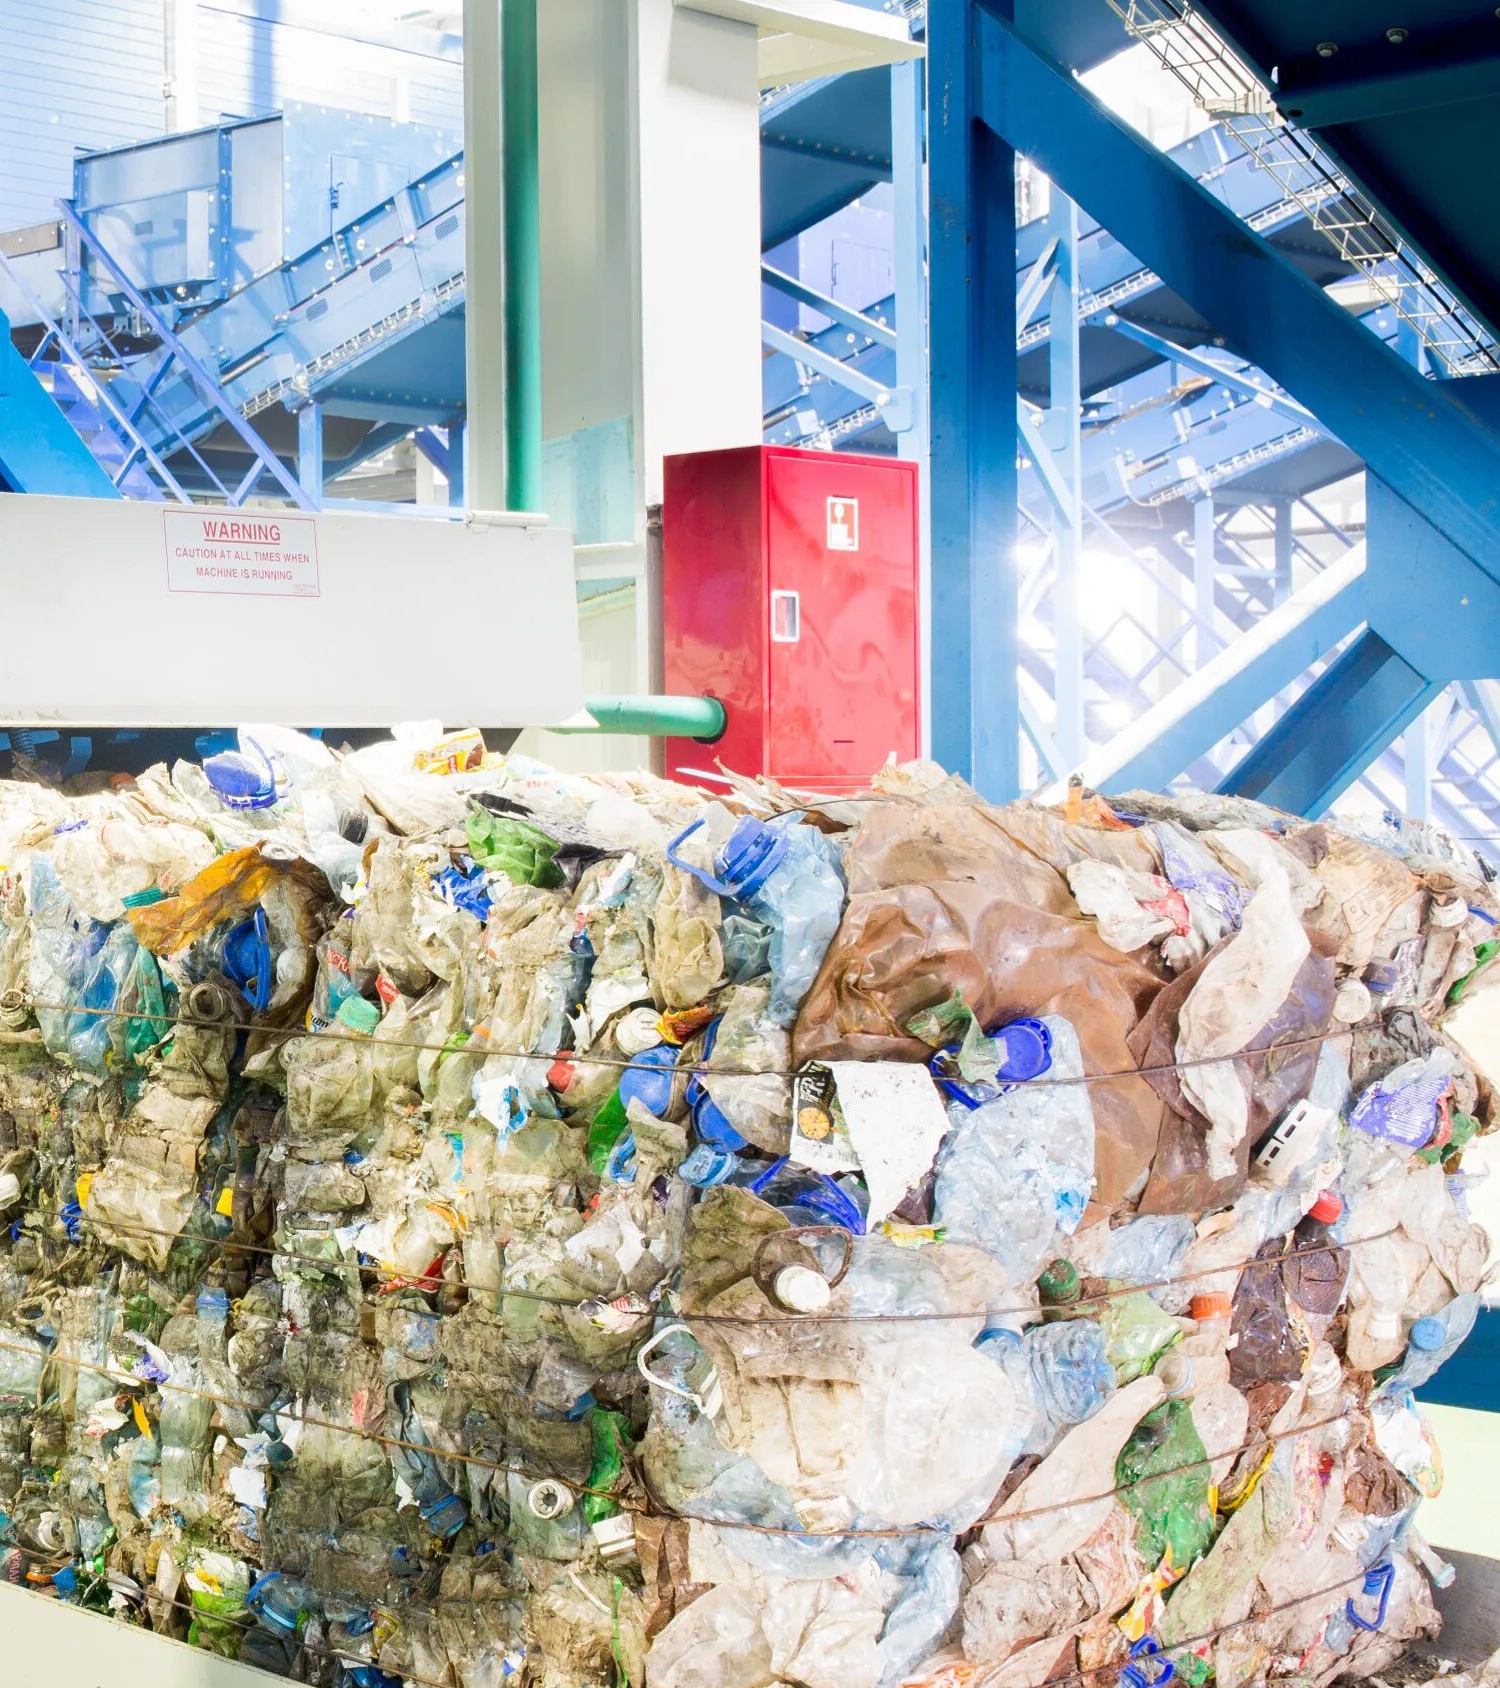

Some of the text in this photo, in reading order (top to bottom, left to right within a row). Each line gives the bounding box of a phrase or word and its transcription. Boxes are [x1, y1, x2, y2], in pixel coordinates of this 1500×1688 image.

[203, 521, 281, 542] WARNING
[175, 547, 310, 564] CAUTION AT ALL TIMES WHEN
[196, 567, 293, 581] MACHINE IS RUNNING
